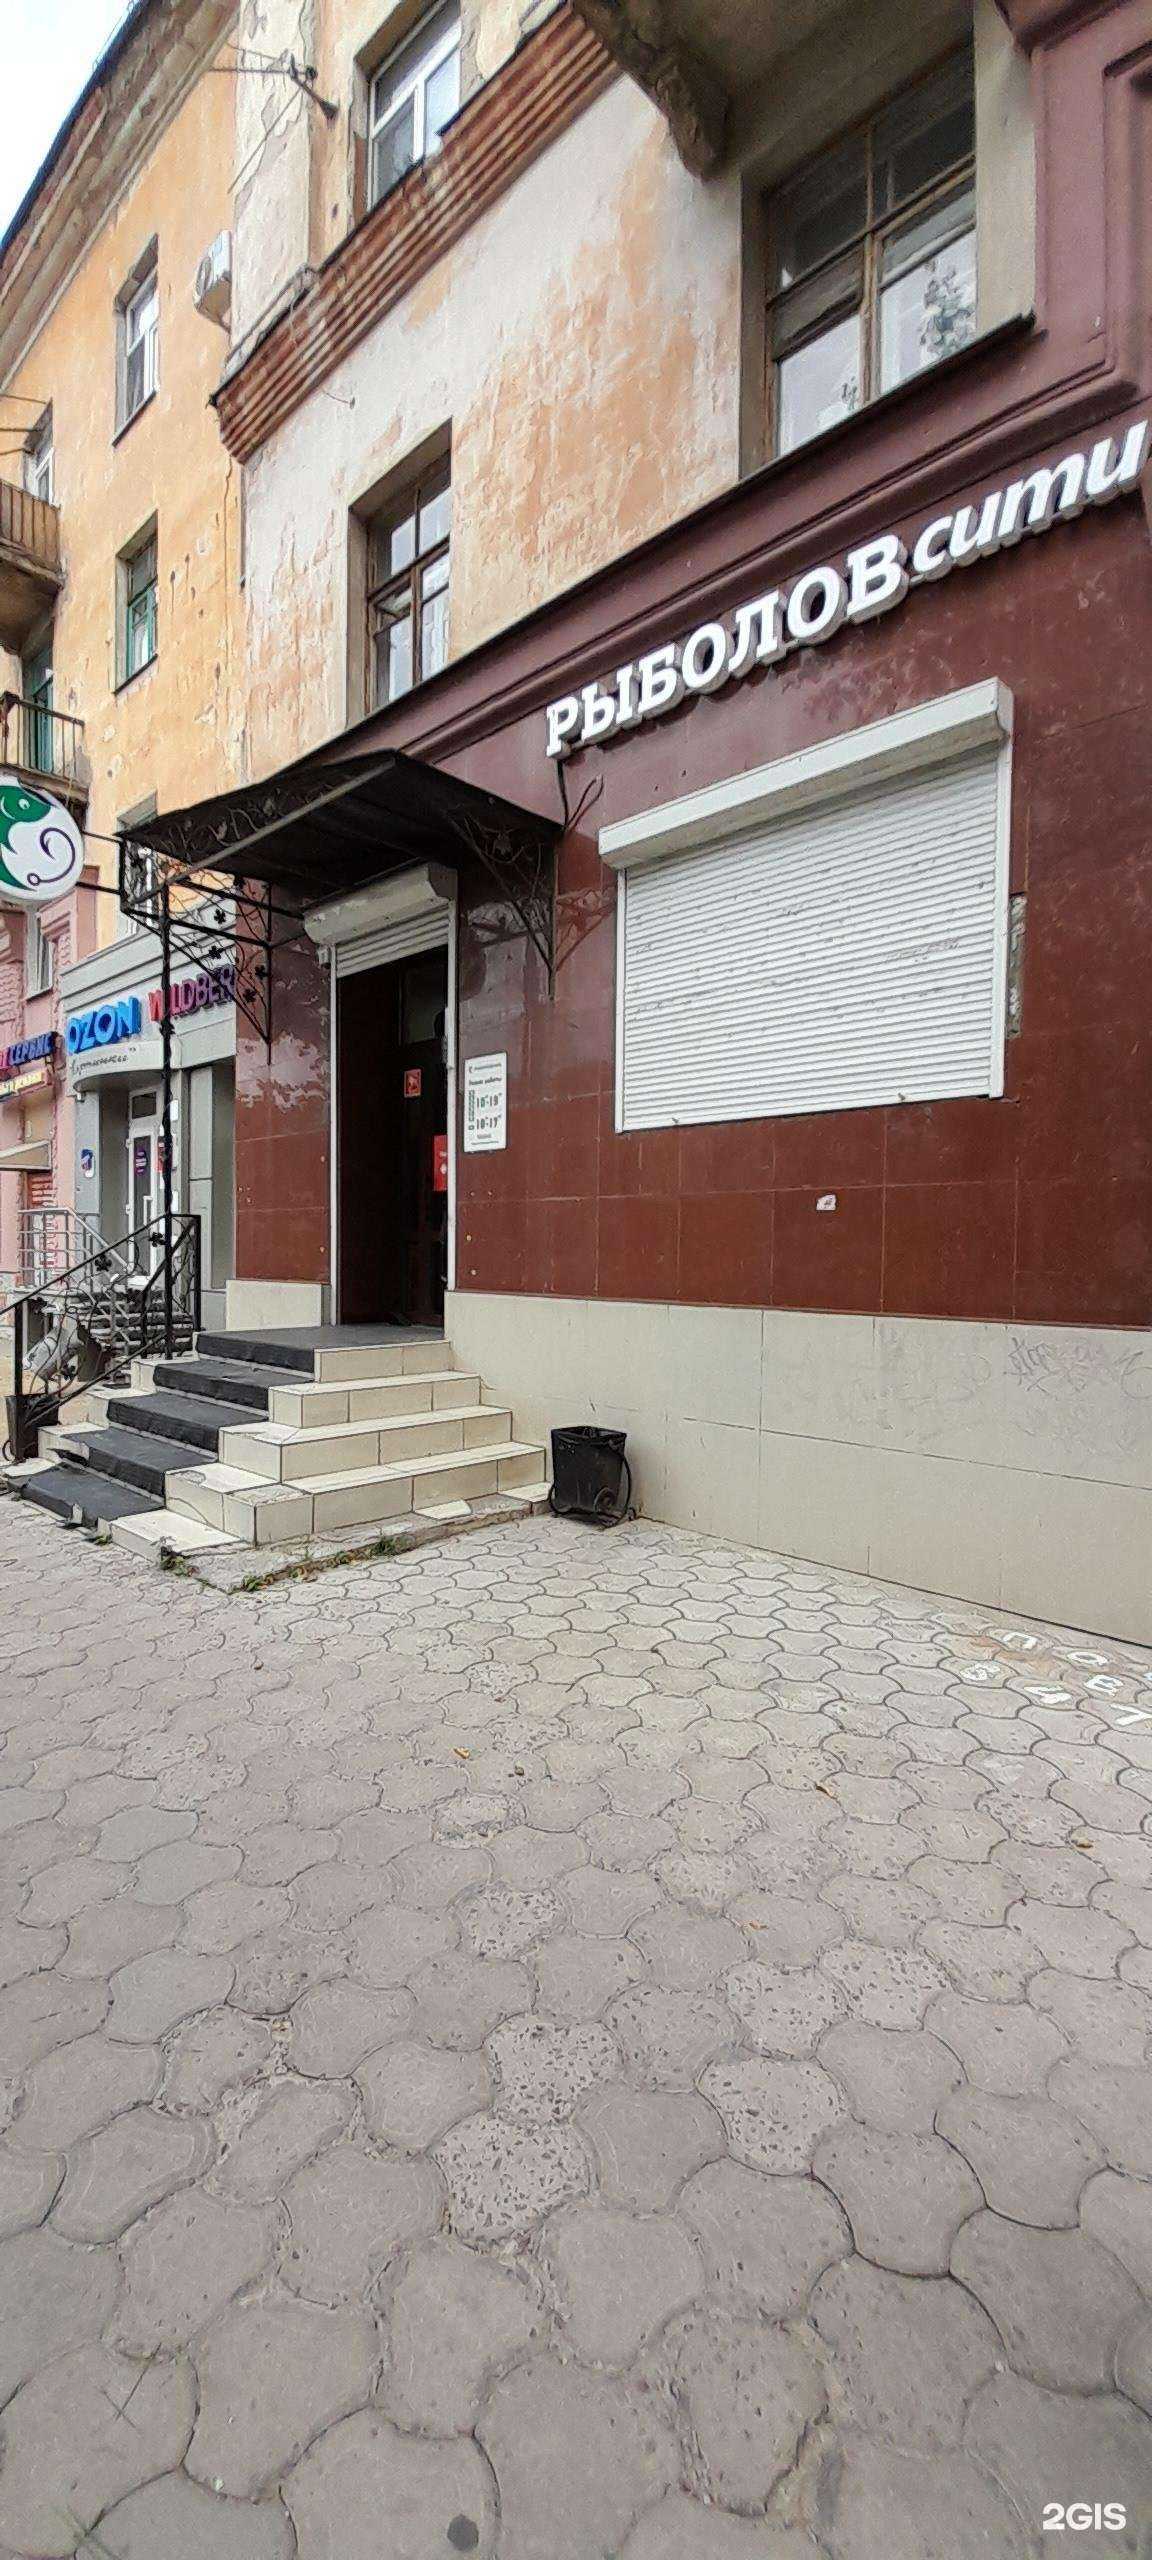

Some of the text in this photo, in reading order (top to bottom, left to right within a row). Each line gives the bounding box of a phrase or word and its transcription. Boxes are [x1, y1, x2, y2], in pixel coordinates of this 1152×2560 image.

[545, 419, 1150, 759] РЫБОЛОВ сити
[66, 996, 142, 1055] OZON
